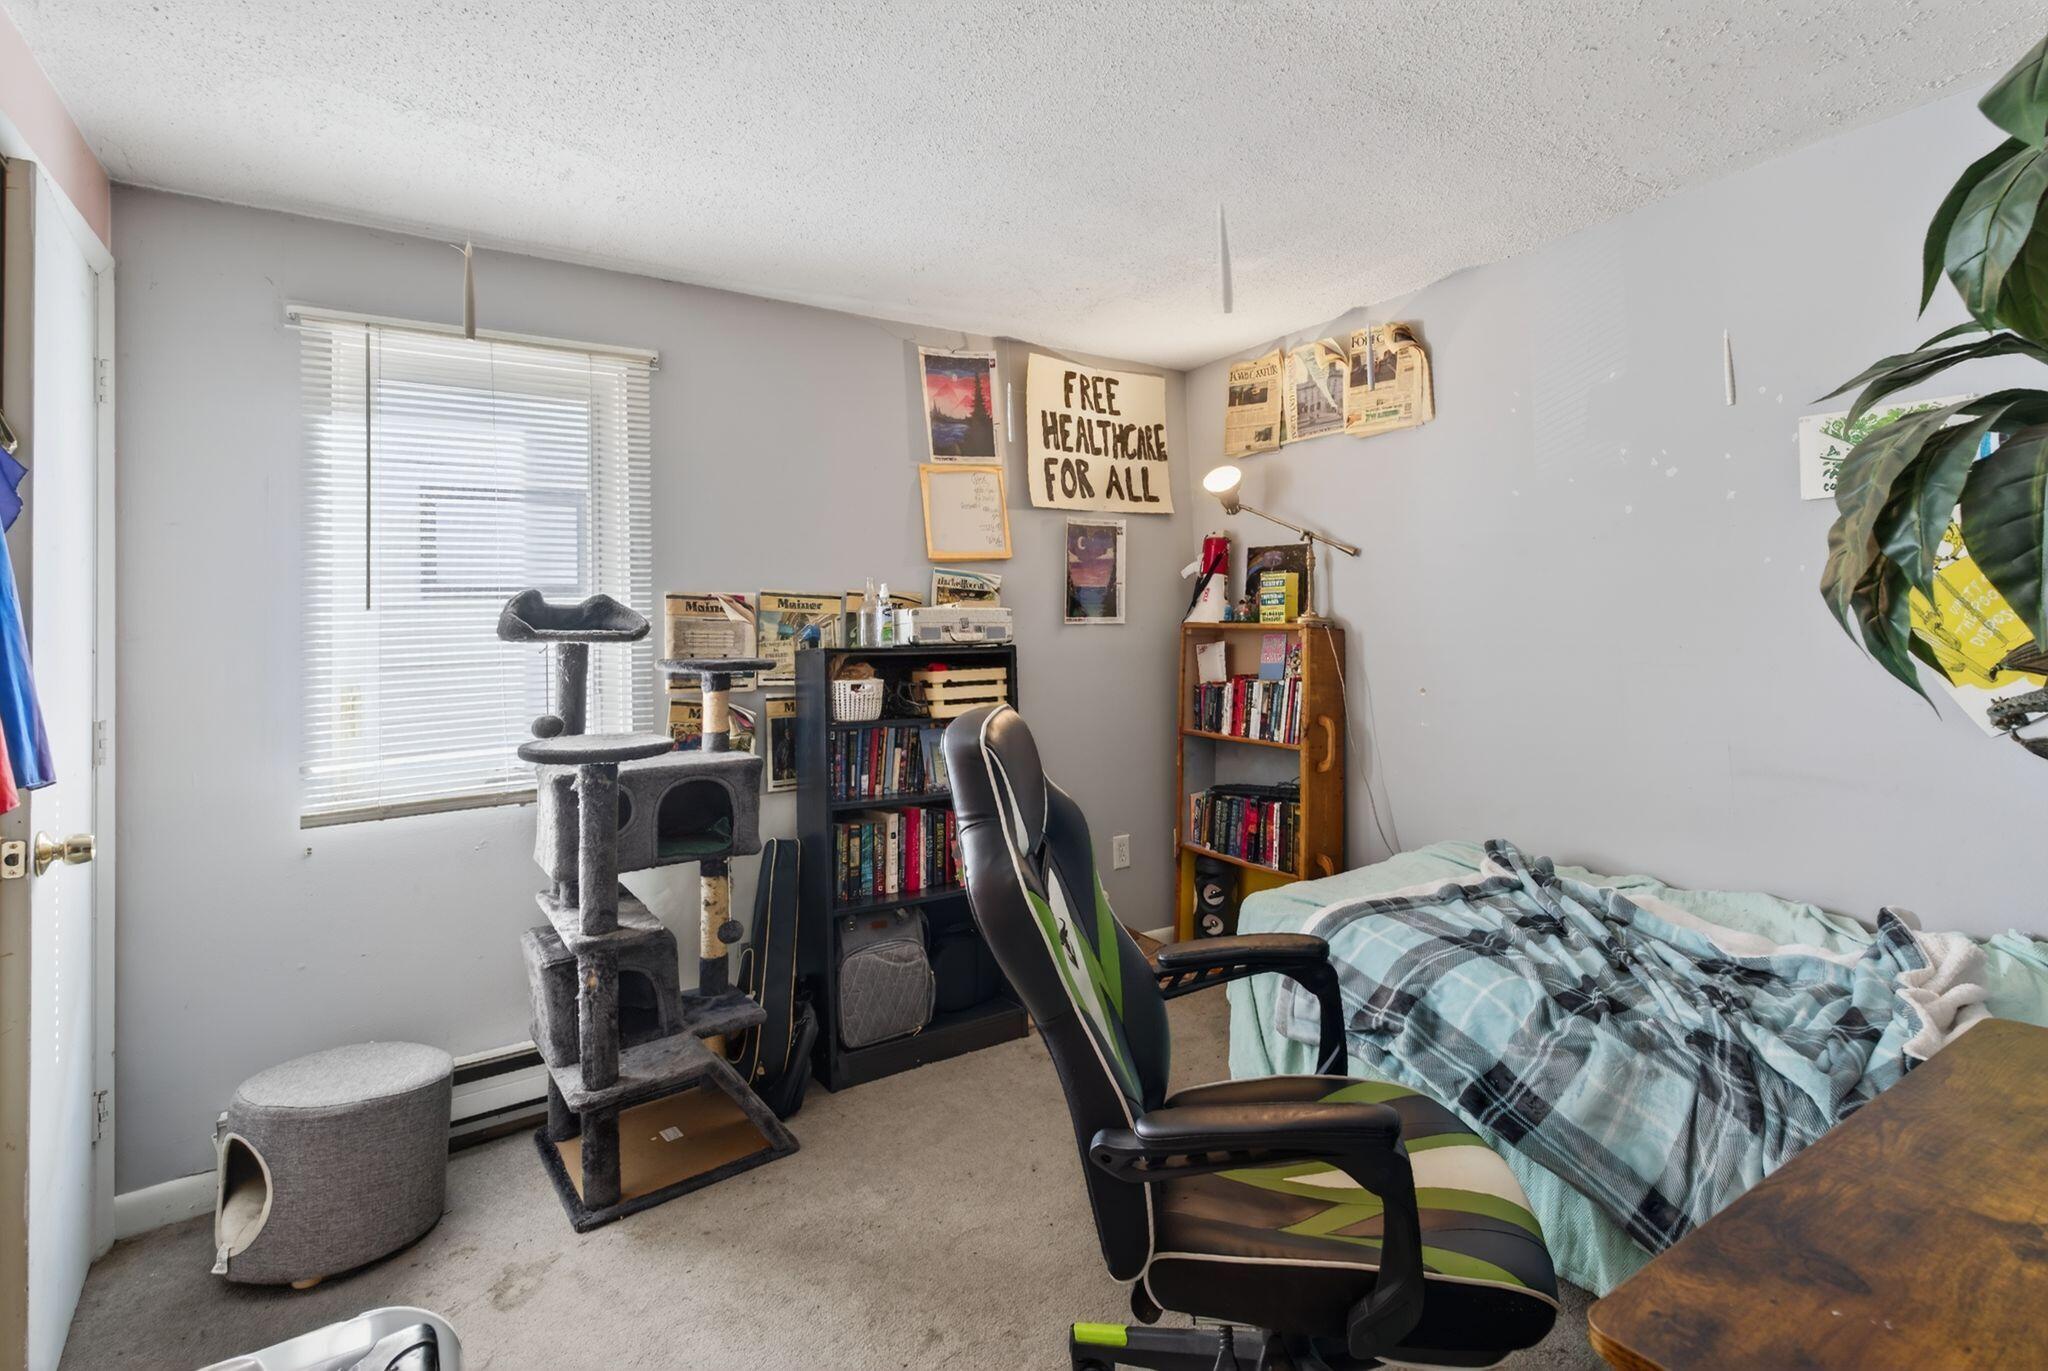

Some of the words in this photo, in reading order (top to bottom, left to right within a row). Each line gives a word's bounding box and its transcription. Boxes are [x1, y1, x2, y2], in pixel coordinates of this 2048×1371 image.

[1063, 370, 1121, 416] FREE
[1041, 410, 1168, 462] HEALTHCARE
[1044, 457, 1095, 502] FOR
[1106, 464, 1160, 502] ALL
[685, 601, 725, 613] Maine
[777, 598, 823, 610] Mainer
